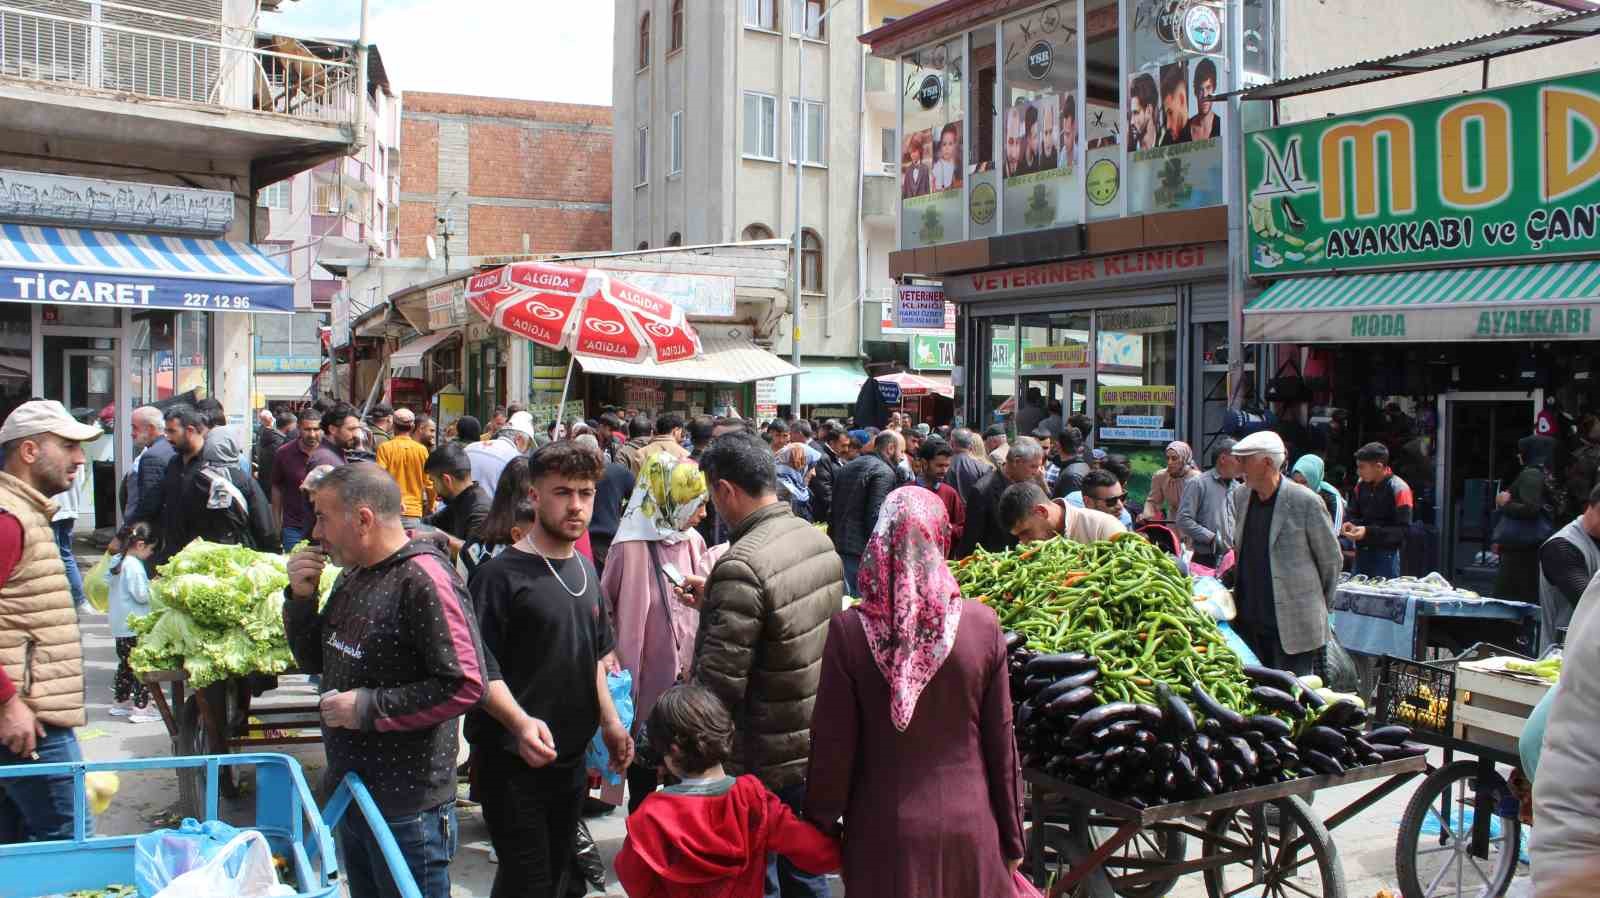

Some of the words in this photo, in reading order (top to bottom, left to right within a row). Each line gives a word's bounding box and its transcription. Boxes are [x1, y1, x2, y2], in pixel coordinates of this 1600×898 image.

[1326, 217, 1472, 258] AYAKKABI
[1483, 222, 1515, 245] ve
[13, 273, 156, 305] TİCARET
[183, 293, 209, 307] 227
[1351, 313, 1406, 337] MODA
[1476, 308, 1593, 335] AYAKKABI
